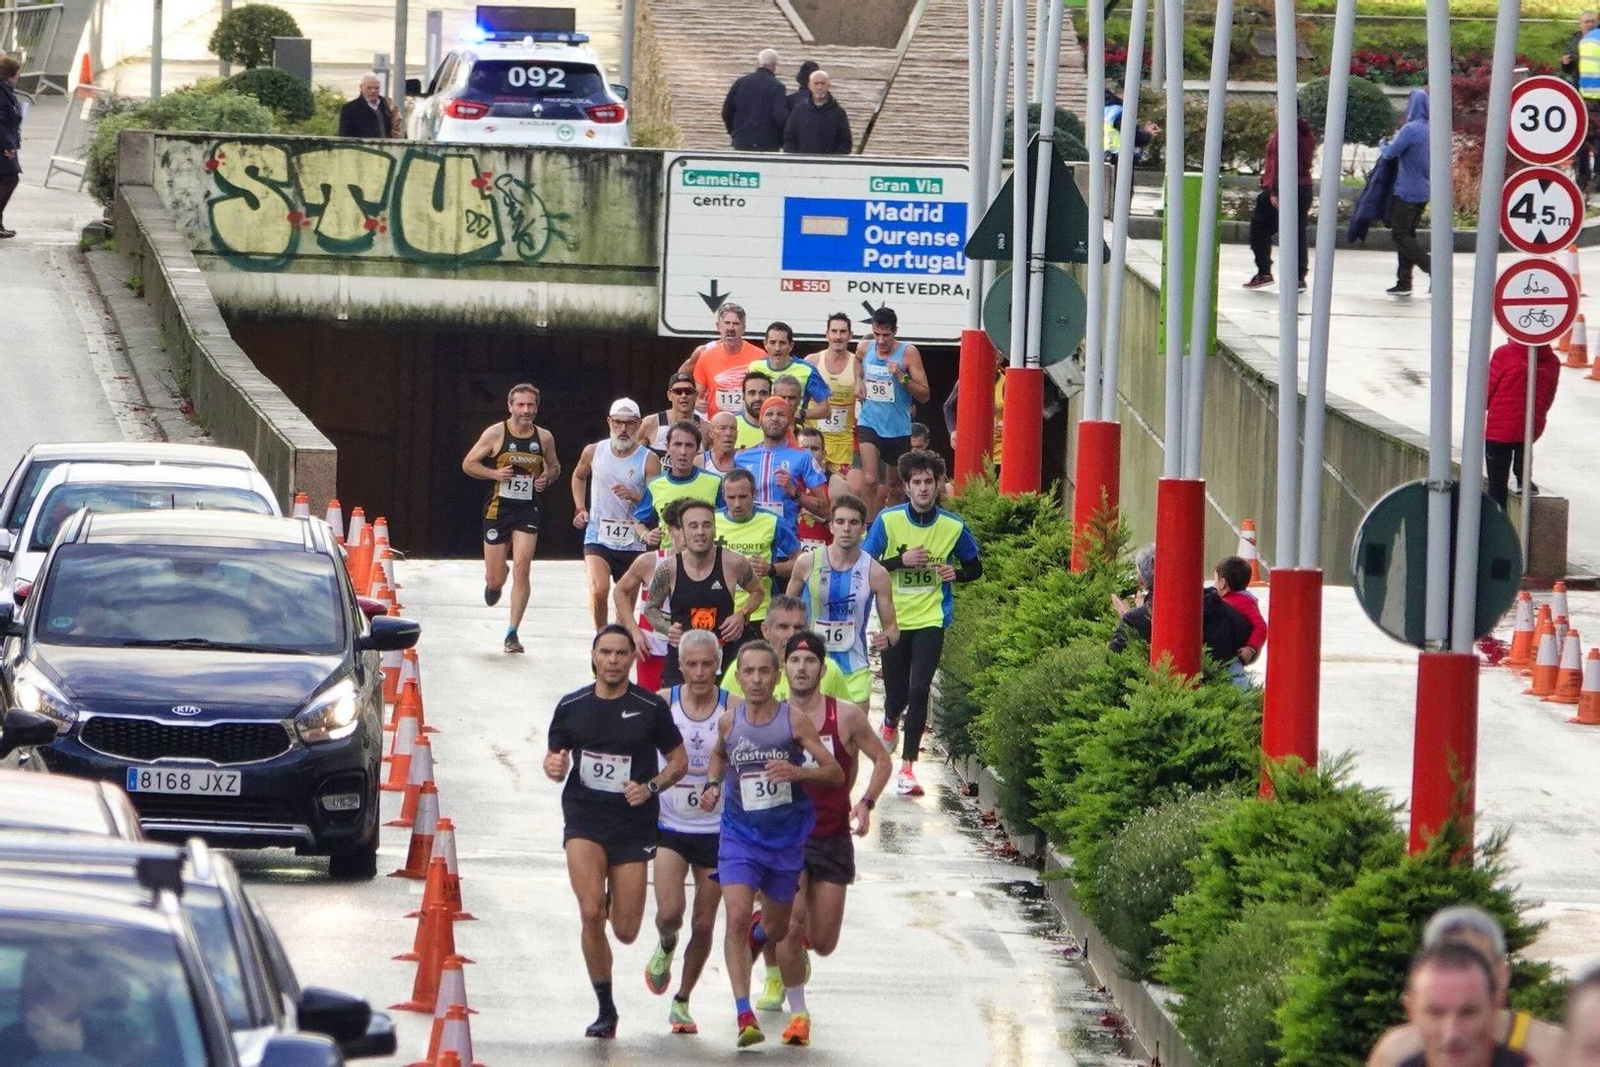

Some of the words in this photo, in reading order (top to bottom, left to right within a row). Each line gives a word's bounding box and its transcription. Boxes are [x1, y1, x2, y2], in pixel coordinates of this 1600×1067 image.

[508, 67, 566, 88] 092
[1519, 104, 1567, 133] 30
[684, 171, 758, 187] Camelias
[872, 178, 910, 192] Gran
[693, 194, 746, 207] centro
[865, 202, 944, 222] Madrid
[864, 225, 960, 247] Ourense
[863, 248, 966, 274] Portugal
[847, 280, 964, 296] PONTEVEDRA
[872, 384, 886, 395] 98
[721, 394, 742, 404] 112
[507, 480, 529, 492] 152
[605, 525, 630, 538] 147
[904, 571, 932, 584] 516
[825, 628, 843, 642] 16
[177, 705, 197, 713] KIA
[593, 762, 615, 780] 92
[141, 771, 191, 791] 8168
[199, 774, 237, 792] JXZ
[754, 781, 778, 797] 30
